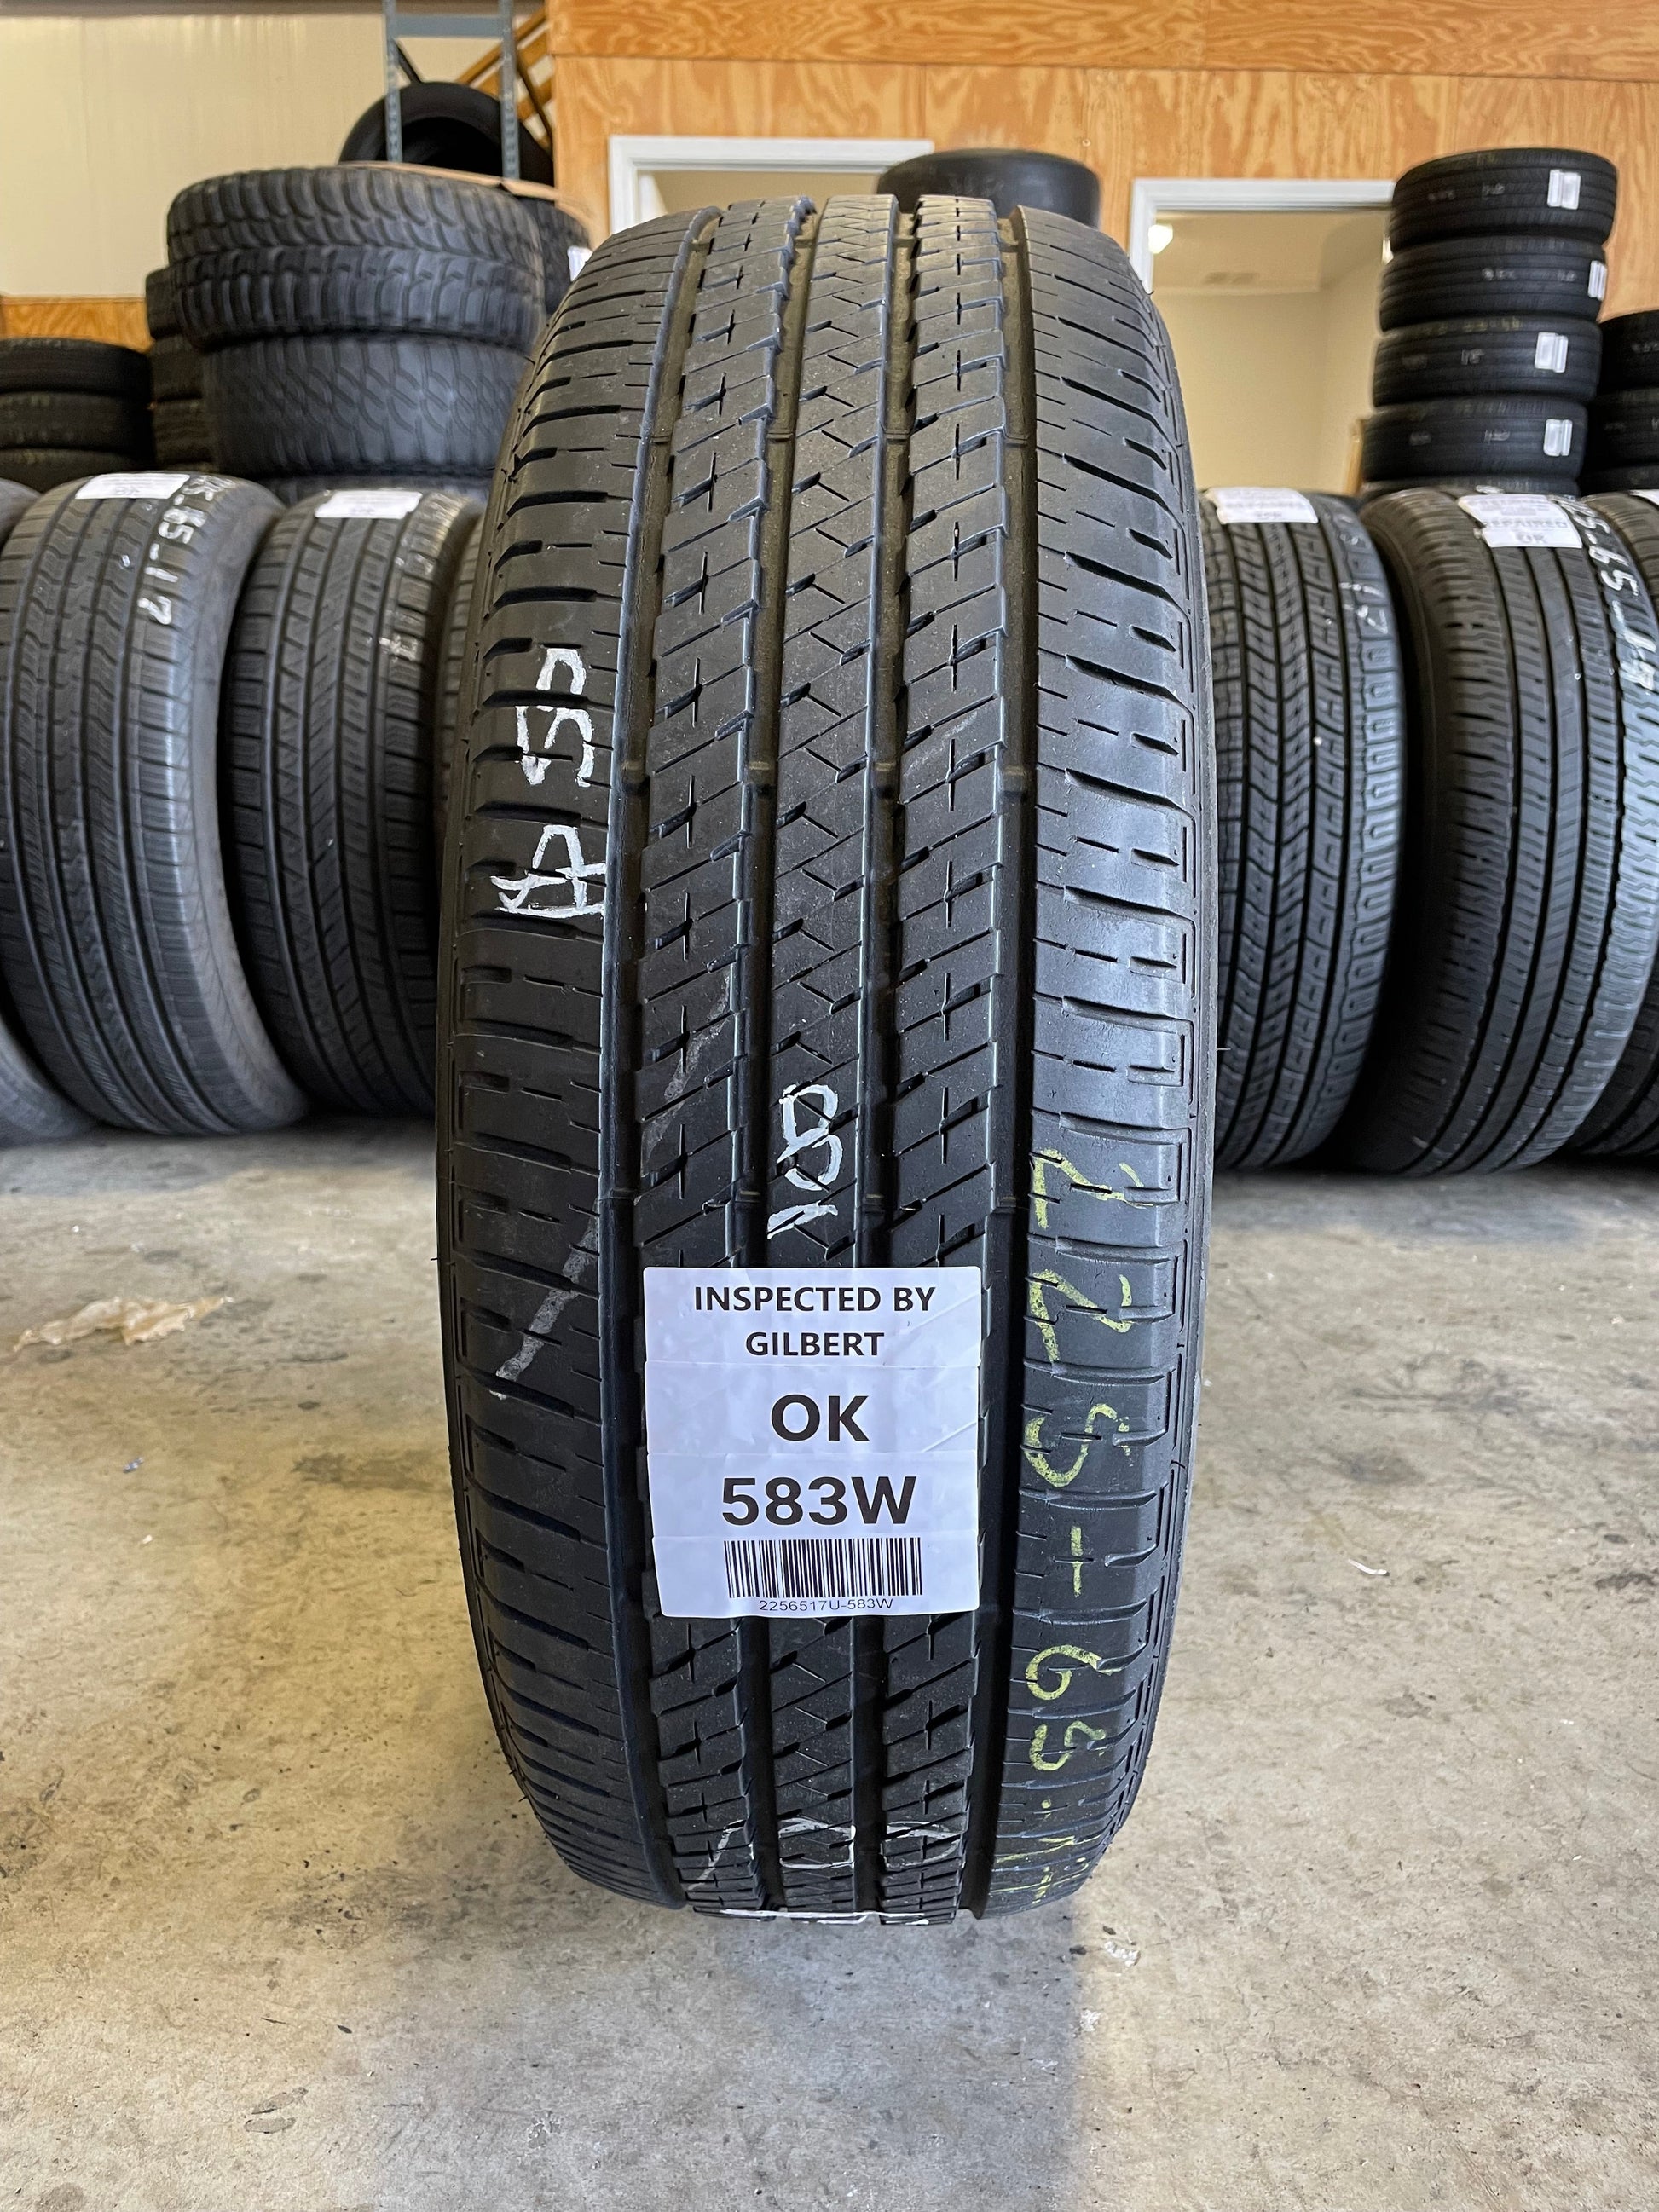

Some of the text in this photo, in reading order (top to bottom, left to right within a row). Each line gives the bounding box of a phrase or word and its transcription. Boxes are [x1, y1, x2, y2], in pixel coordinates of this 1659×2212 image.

[694, 1285, 937, 1312] INSPECTED BY
[745, 1331, 885, 1357] GILBERT
[770, 1394, 870, 1442] OK
[721, 1476, 917, 1527] 583W
[758, 1597, 894, 1612] 2256517U-583W
